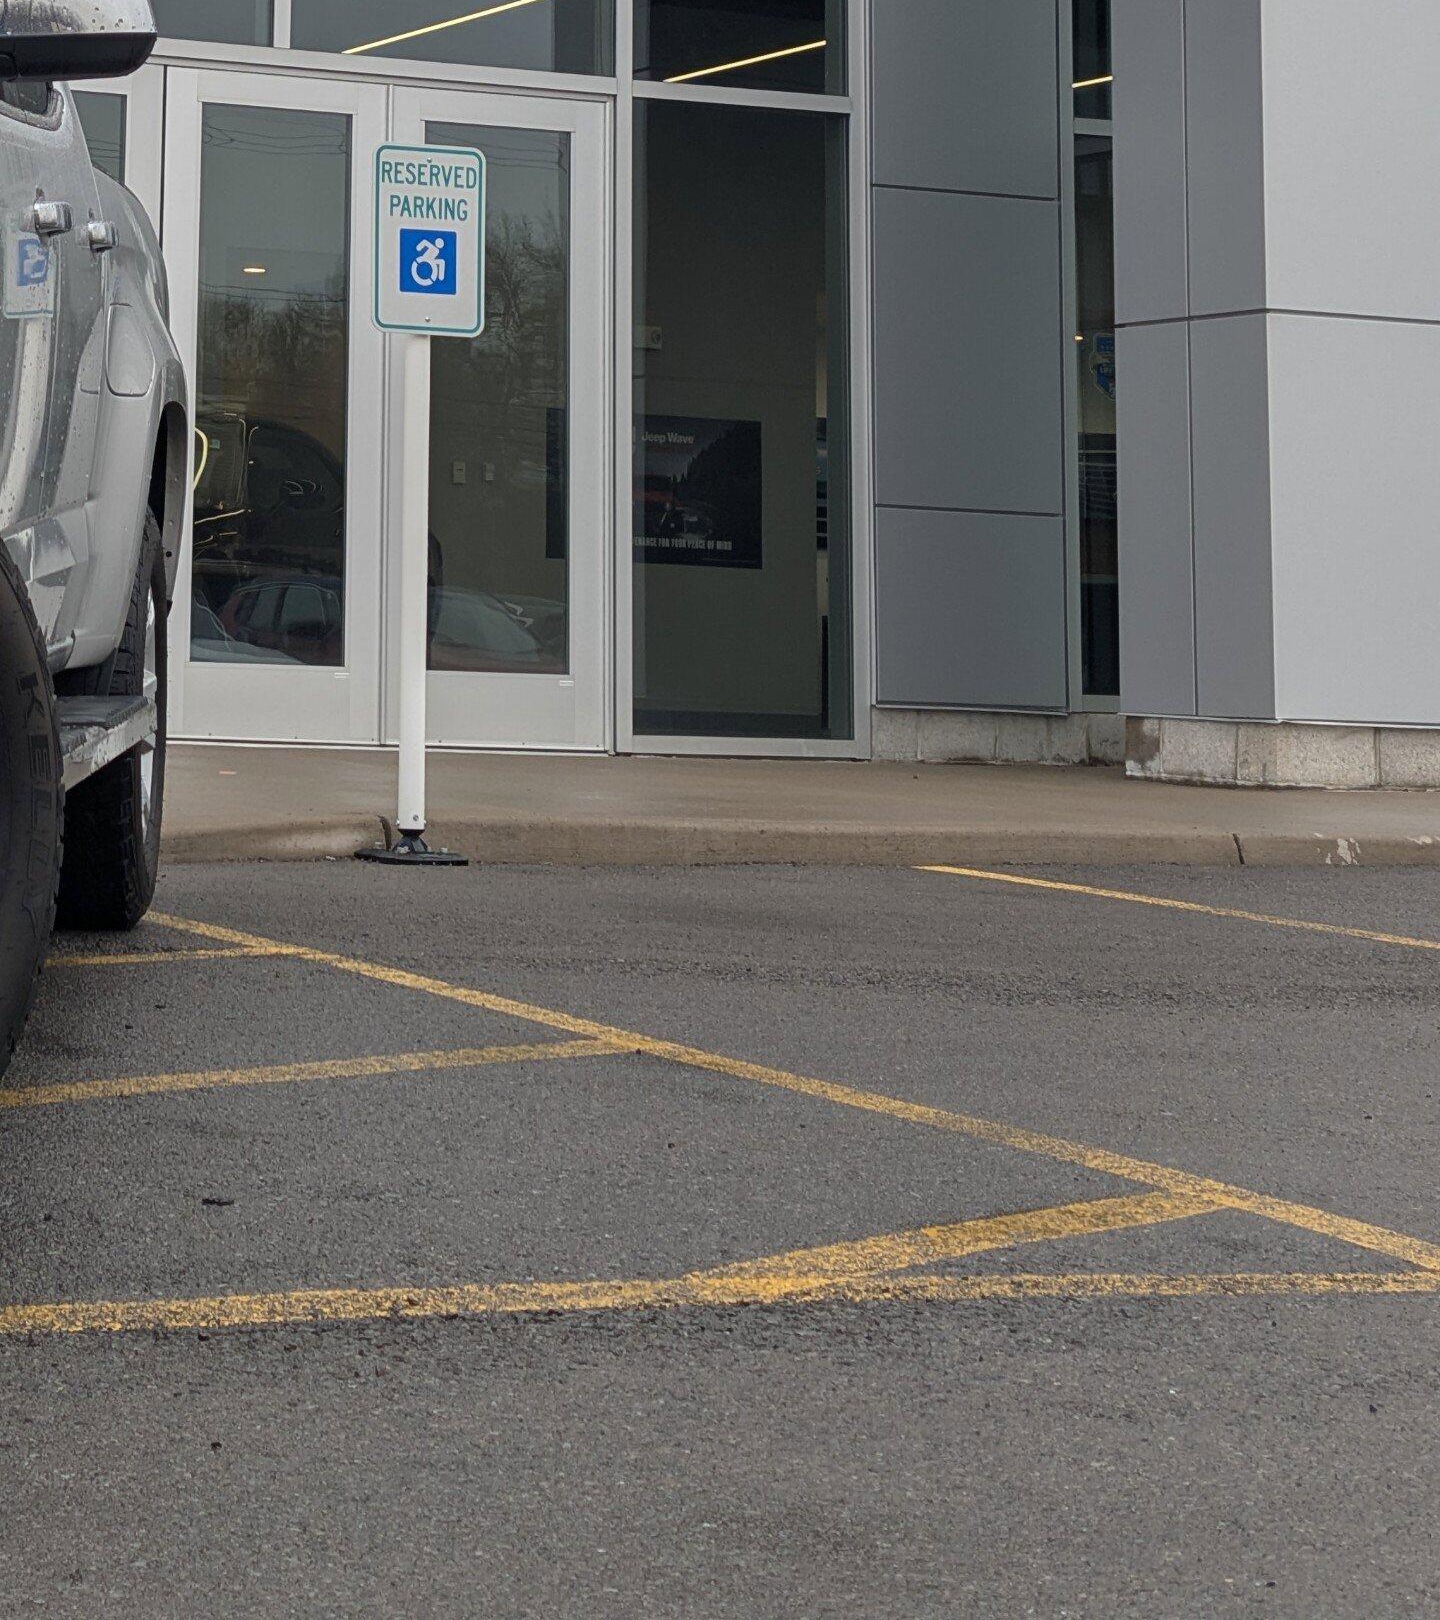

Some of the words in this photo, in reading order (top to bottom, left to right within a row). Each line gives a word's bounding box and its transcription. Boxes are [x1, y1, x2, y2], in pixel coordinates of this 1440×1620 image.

[381, 161, 477, 189] RESERVED
[389, 194, 468, 222] PARKING
[641, 431, 666, 444] Jeep
[666, 432, 695, 444] Wave
